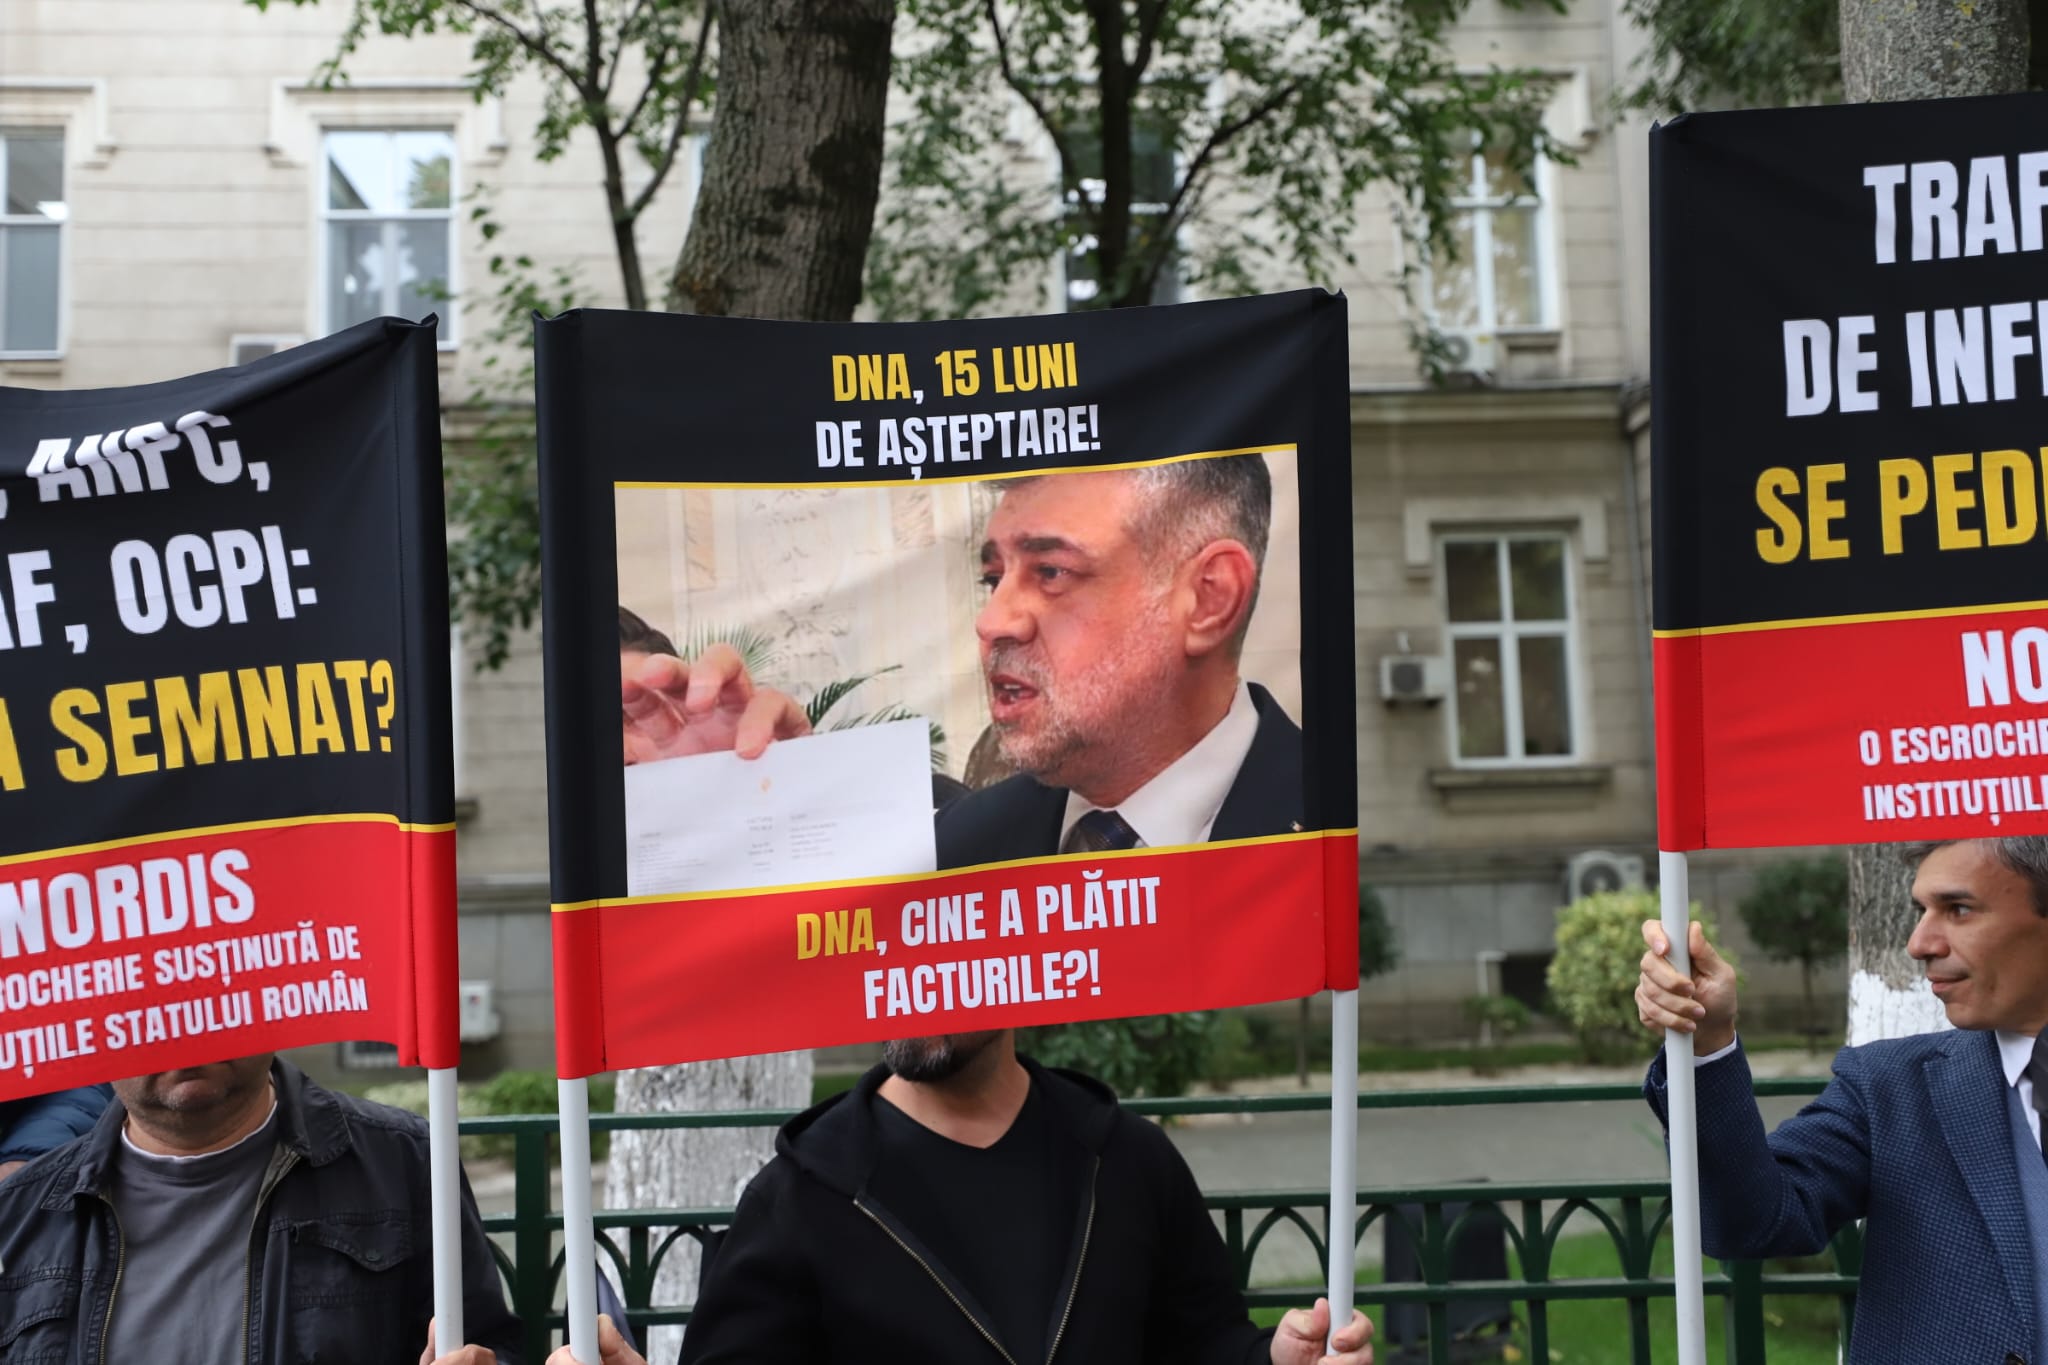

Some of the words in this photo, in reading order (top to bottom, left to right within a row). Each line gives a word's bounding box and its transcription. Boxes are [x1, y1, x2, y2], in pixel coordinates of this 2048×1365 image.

[1864, 150, 2048, 265] TRAF
[832, 353, 925, 405] DNA,
[934, 349, 980, 397] 15
[992, 341, 1078, 394] LUNI
[1782, 314, 1879, 417] DE
[1905, 299, 2048, 408] INF
[25, 409, 271, 503] ANPC,
[815, 420, 865, 468] DE
[877, 404, 1101, 481] AȘTEPTARE!
[1755, 462, 1850, 564] SE
[1878, 446, 2048, 555] PED
[0, 549, 90, 655] F,
[110, 524, 318, 635] OCPI:
[1961, 626, 2048, 708] NO
[49, 659, 396, 783] SEMNAT?
[1859, 730, 1881, 767] O
[0, 848, 255, 959] NORDIS
[796, 907, 888, 960] DNA,
[901, 891, 987, 948] CINE
[999, 888, 1025, 938] A
[1036, 868, 1161, 934] PLĂTIT
[0, 953, 145, 1014] OCHERIE
[154, 920, 320, 987] SUSȚINUTĂ
[326, 925, 362, 961] DE
[105, 990, 254, 1050] STATULUI
[262, 969, 369, 1022] ROMÂN
[863, 948, 1102, 1020] FACTURILE?!
